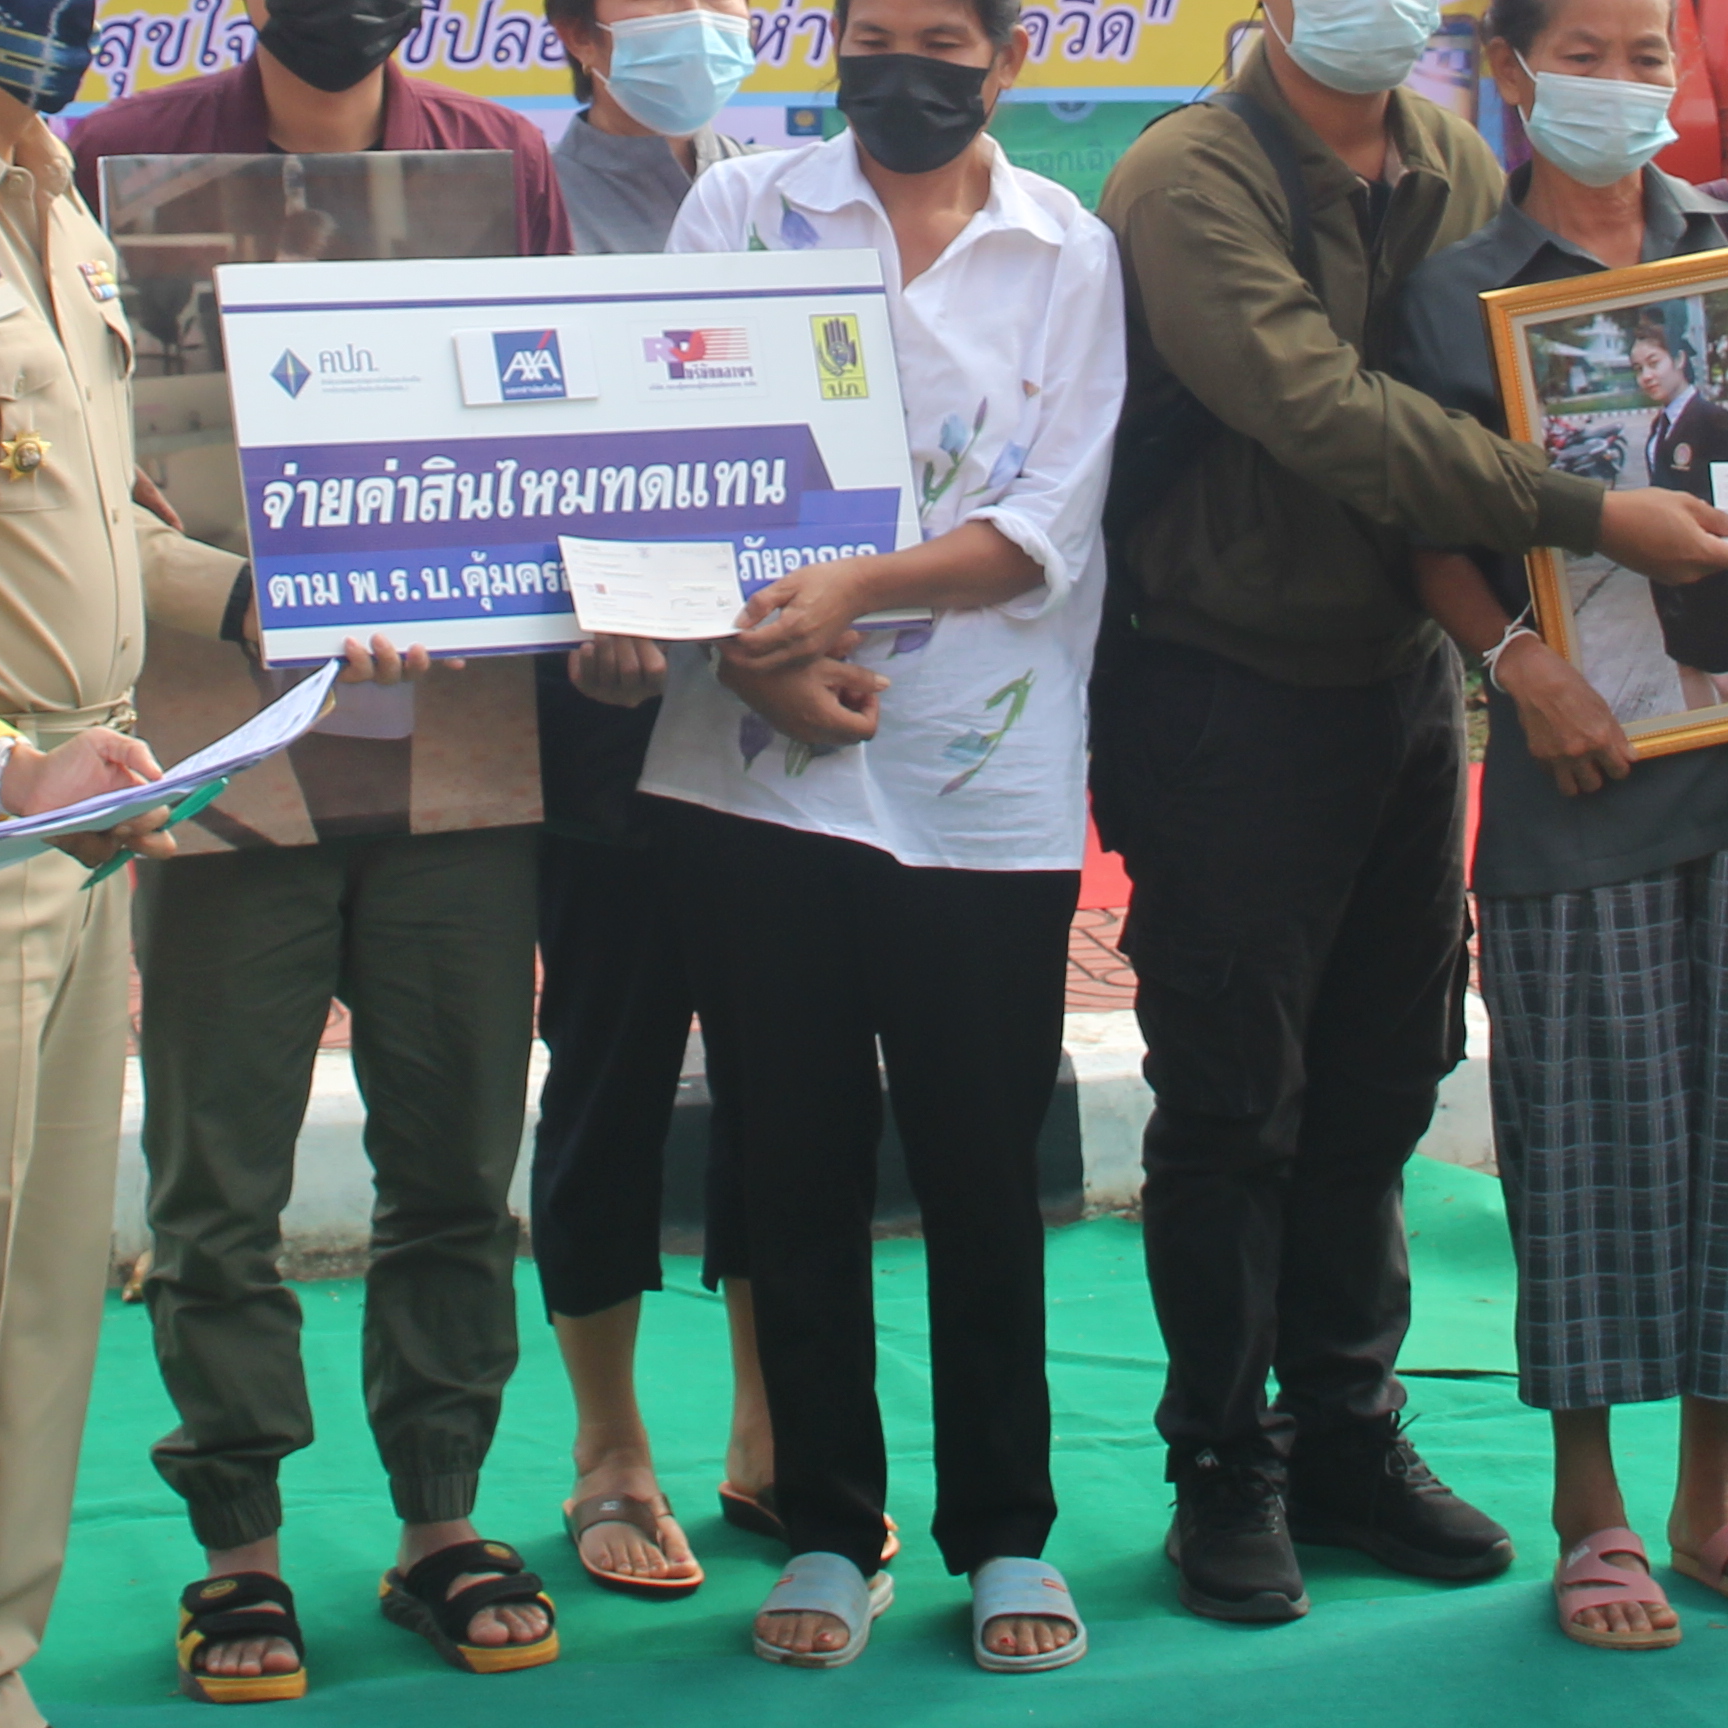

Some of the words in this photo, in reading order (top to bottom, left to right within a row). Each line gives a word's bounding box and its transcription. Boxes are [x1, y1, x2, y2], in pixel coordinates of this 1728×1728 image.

[318, 341, 380, 374] คปภ.
[502, 349, 561, 382] AXA
[261, 455, 787, 530] จ่ายค่าสินไหมทดแทน
[268, 571, 339, 609] ตาม
